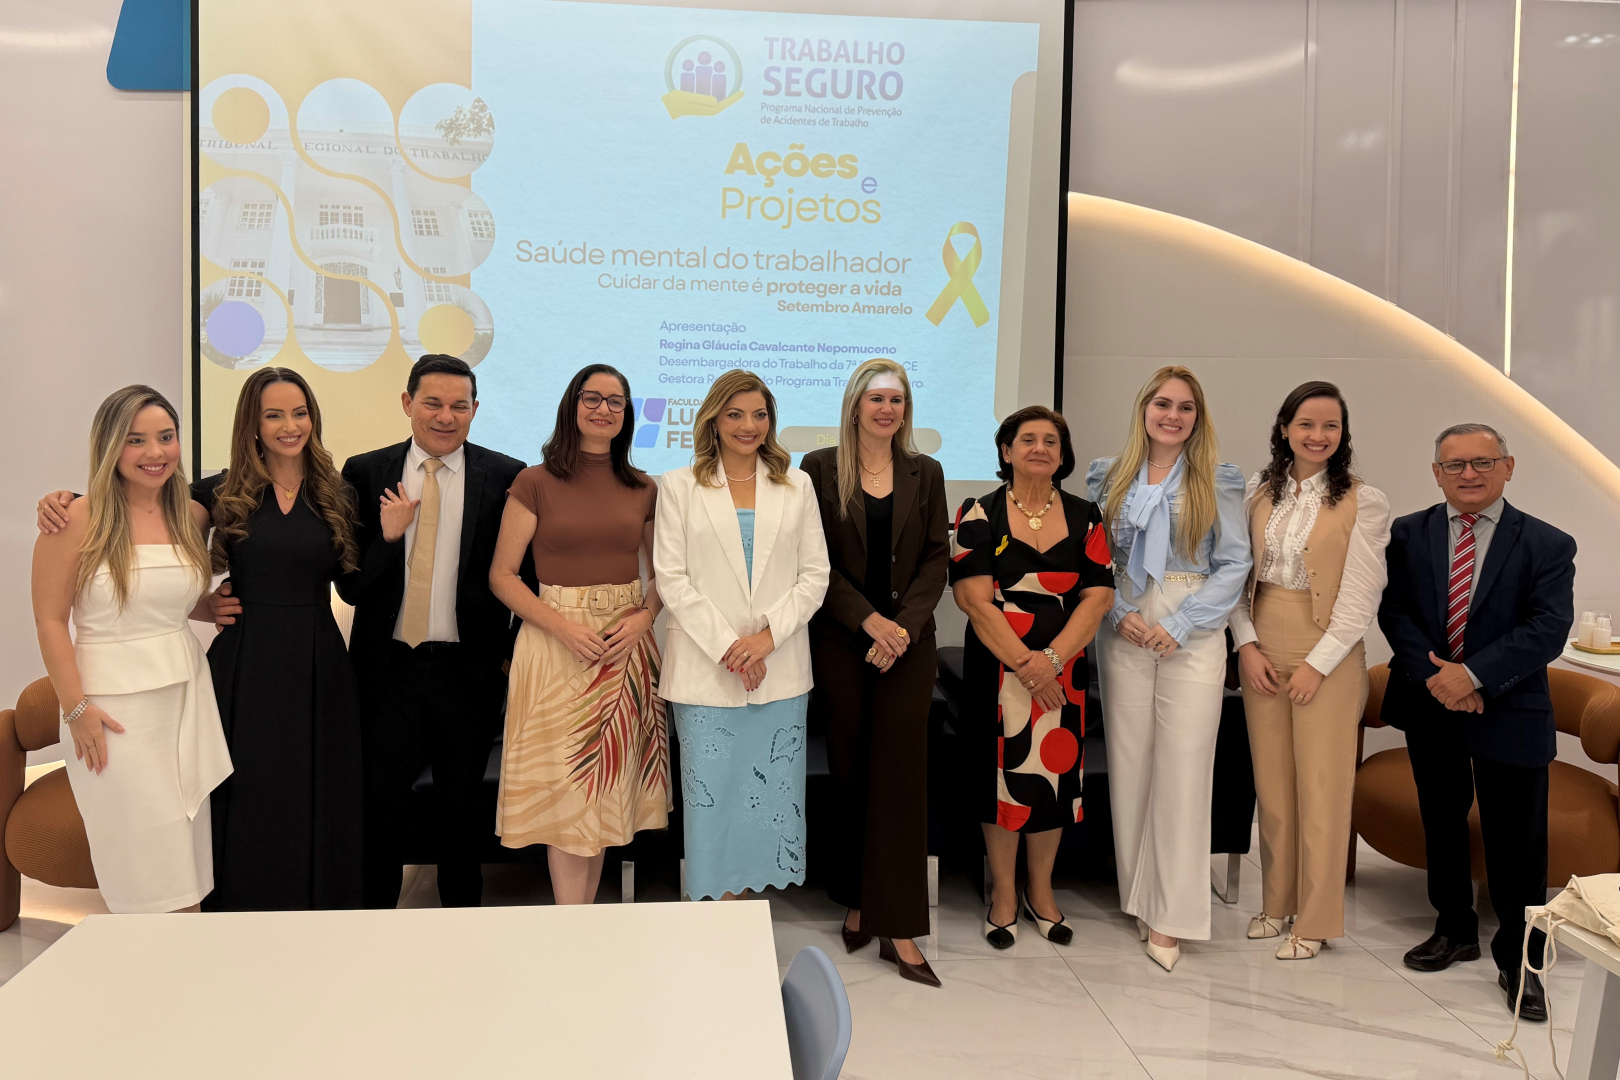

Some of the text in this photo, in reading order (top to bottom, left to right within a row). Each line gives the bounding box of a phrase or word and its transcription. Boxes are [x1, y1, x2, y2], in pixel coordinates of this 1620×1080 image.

[763, 37, 905, 65] TRABALHO
[762, 66, 904, 101] SEGURO
[760, 102, 902, 118] Programa Nacional de Prevenção
[760, 115, 869, 128] de Acidentes de Trabalho
[724, 142, 858, 188] Ações
[861, 176, 878, 194] e
[721, 187, 881, 229] Projetos
[516, 239, 912, 274] Saúde mental do trabalhador
[597, 273, 902, 298] Cuidar da mente é proteger a vida
[777, 300, 913, 315] Setembro Amarelo
[659, 320, 747, 335] Apresentação
[659, 339, 897, 355] Regina Gláucia Cavalcante Nepomuceno
[659, 356, 760, 369] Desembargadora
[762, 358, 777, 368] do
[779, 359, 828, 369] Trabalho
[829, 359, 844, 370] da
[658, 373, 704, 384] Gestora
[776, 376, 831, 388] Programa
